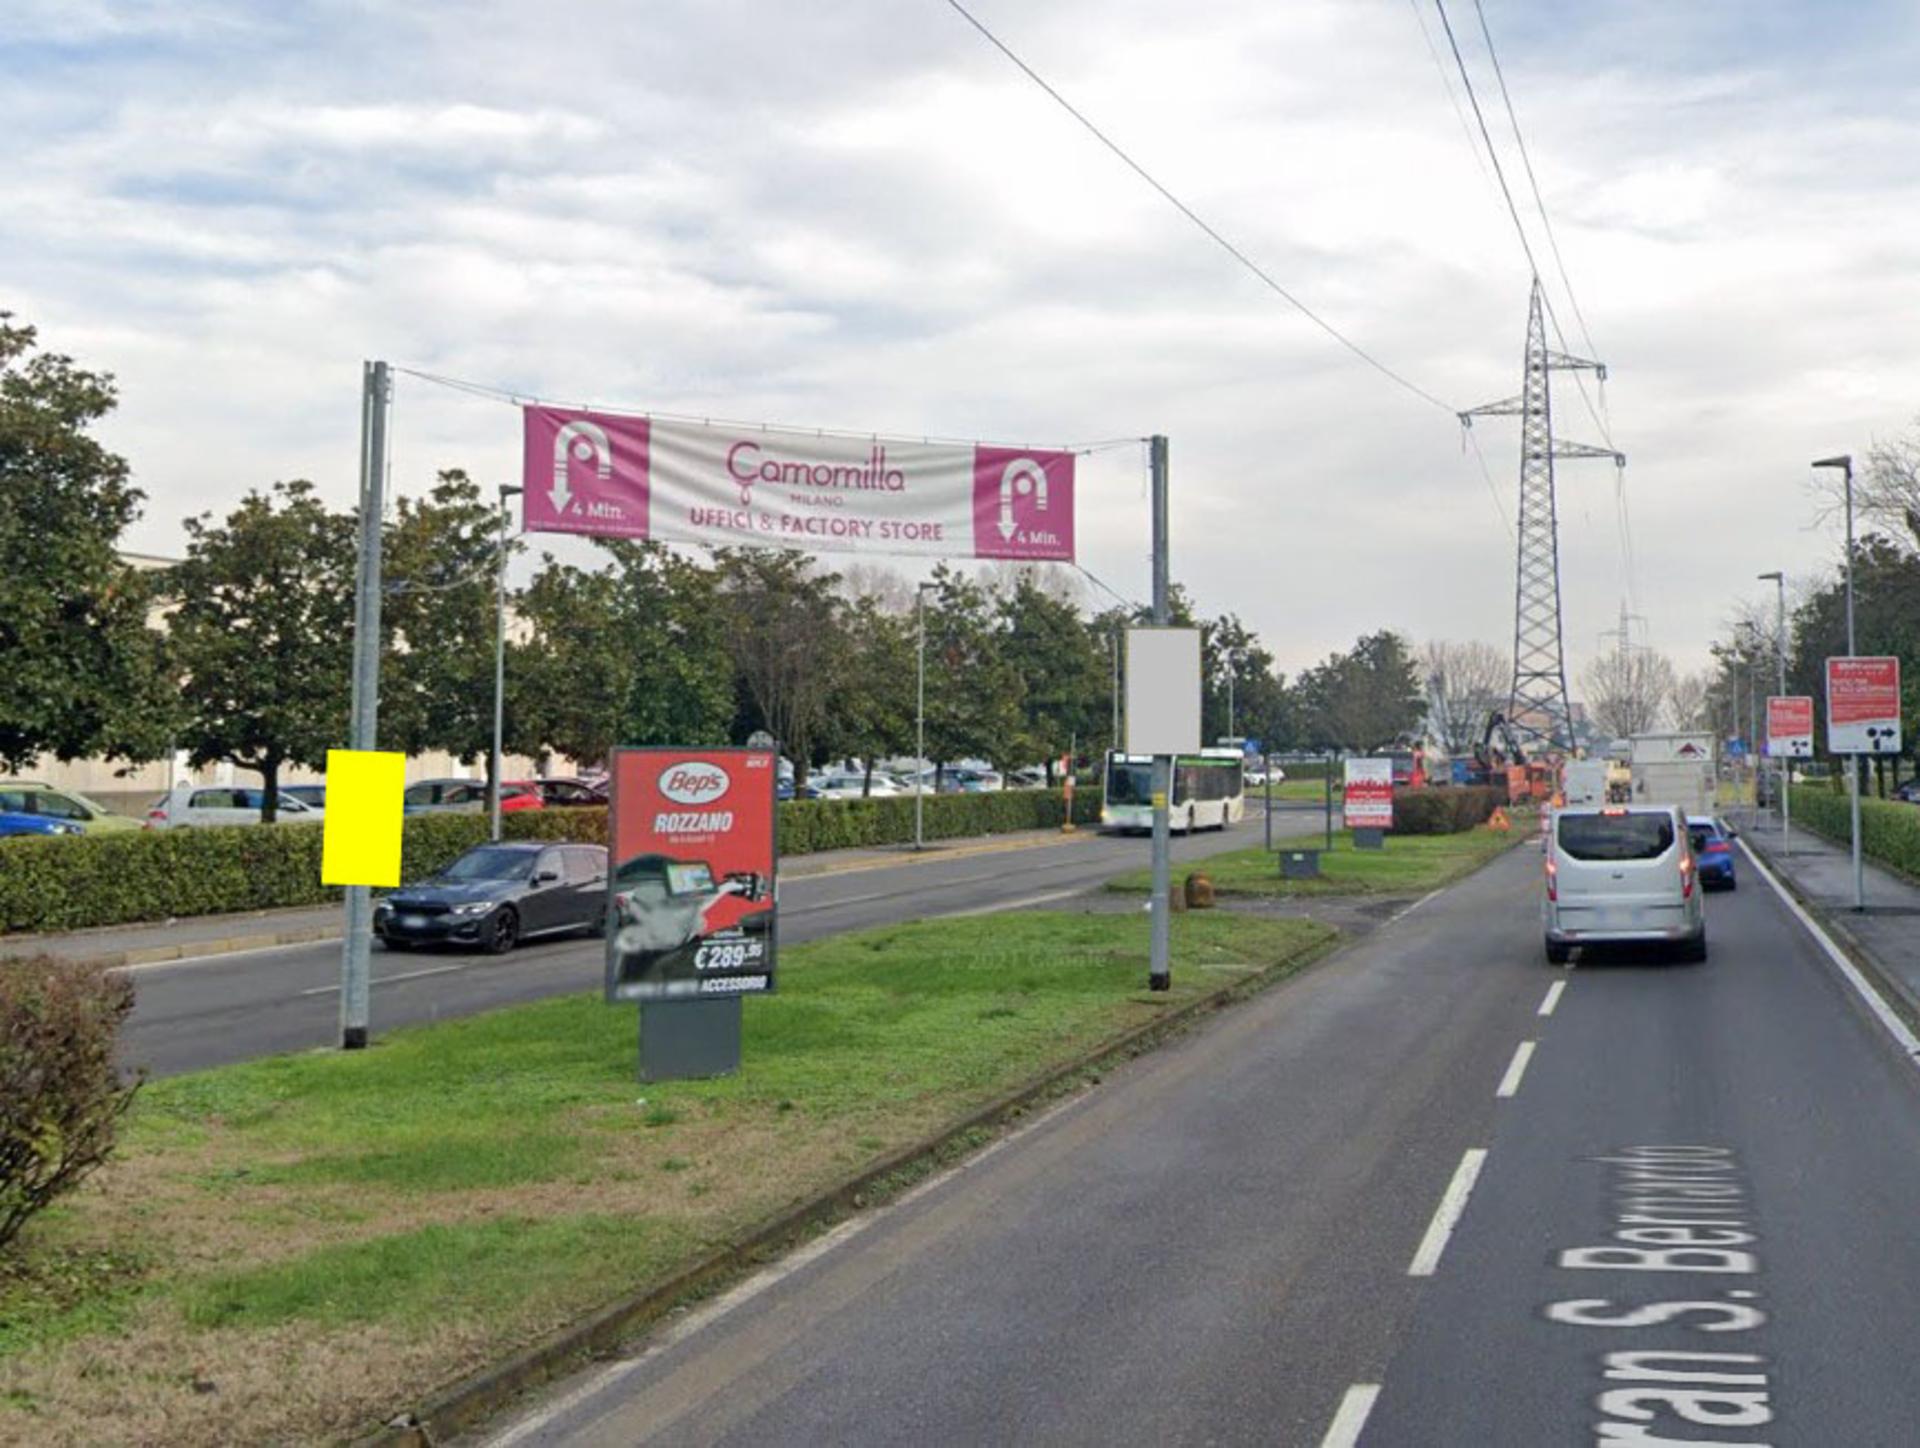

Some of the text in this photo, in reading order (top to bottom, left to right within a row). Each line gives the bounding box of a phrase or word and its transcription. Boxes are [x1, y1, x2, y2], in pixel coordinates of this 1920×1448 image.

[727, 441, 905, 491] Camomilla
[571, 501, 627, 520] 4 Min.
[690, 507, 945, 542] UFFICI & FACTORY STORE
[654, 811, 733, 833] ROZZANO
